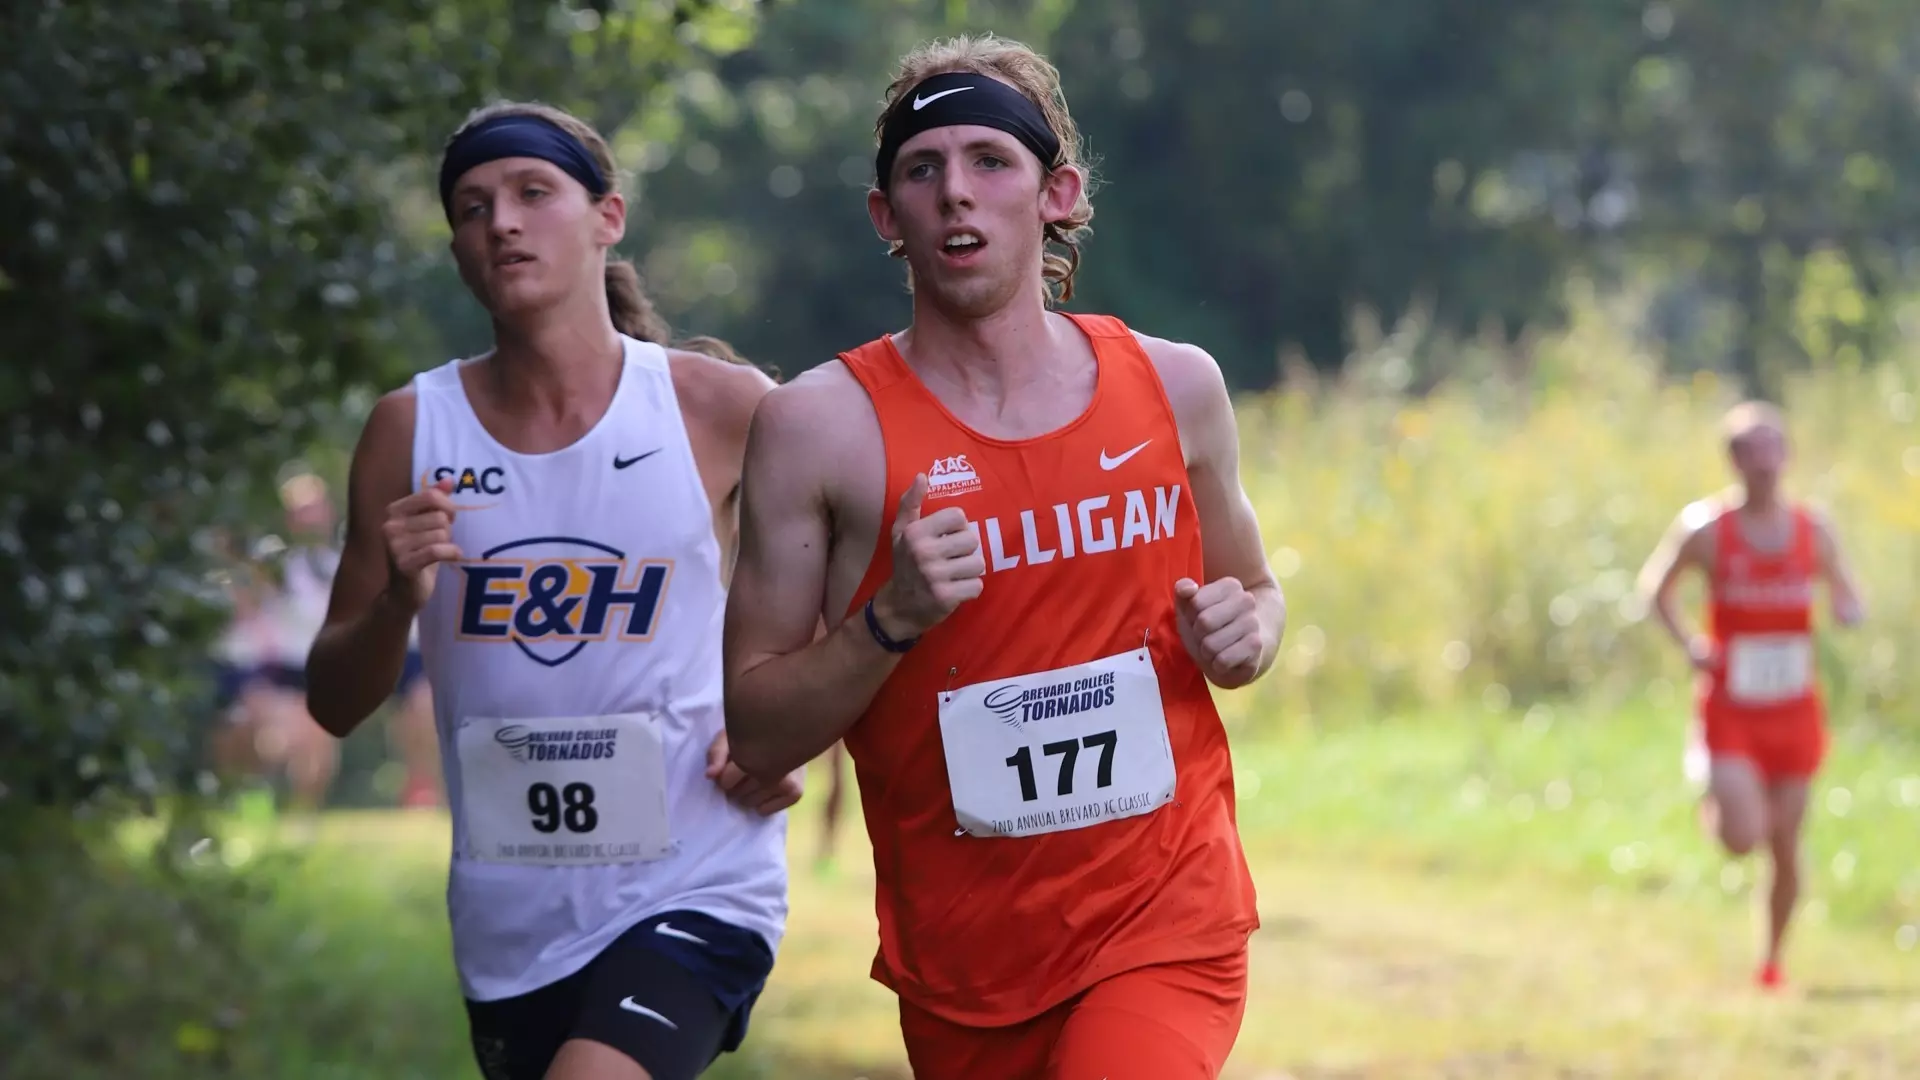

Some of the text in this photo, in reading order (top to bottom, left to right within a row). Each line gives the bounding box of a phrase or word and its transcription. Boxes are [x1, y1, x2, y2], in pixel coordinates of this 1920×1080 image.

[434, 466, 505, 496] SAC
[932, 454, 969, 476] AAC
[927, 476, 981, 494] APPALACHIAN
[967, 485, 1181, 577] LLIGAN
[460, 564, 668, 636] E&H
[1021, 685, 1115, 723] TORNADOS
[1022, 672, 1114, 702] BREVARD COLLEGE
[528, 742, 616, 760] TORNADOS
[1006, 730, 1117, 801] 177
[527, 781, 598, 834] 98
[992, 791, 1152, 834] 2ND ANNUAL BREVARD XC CLASSIC
